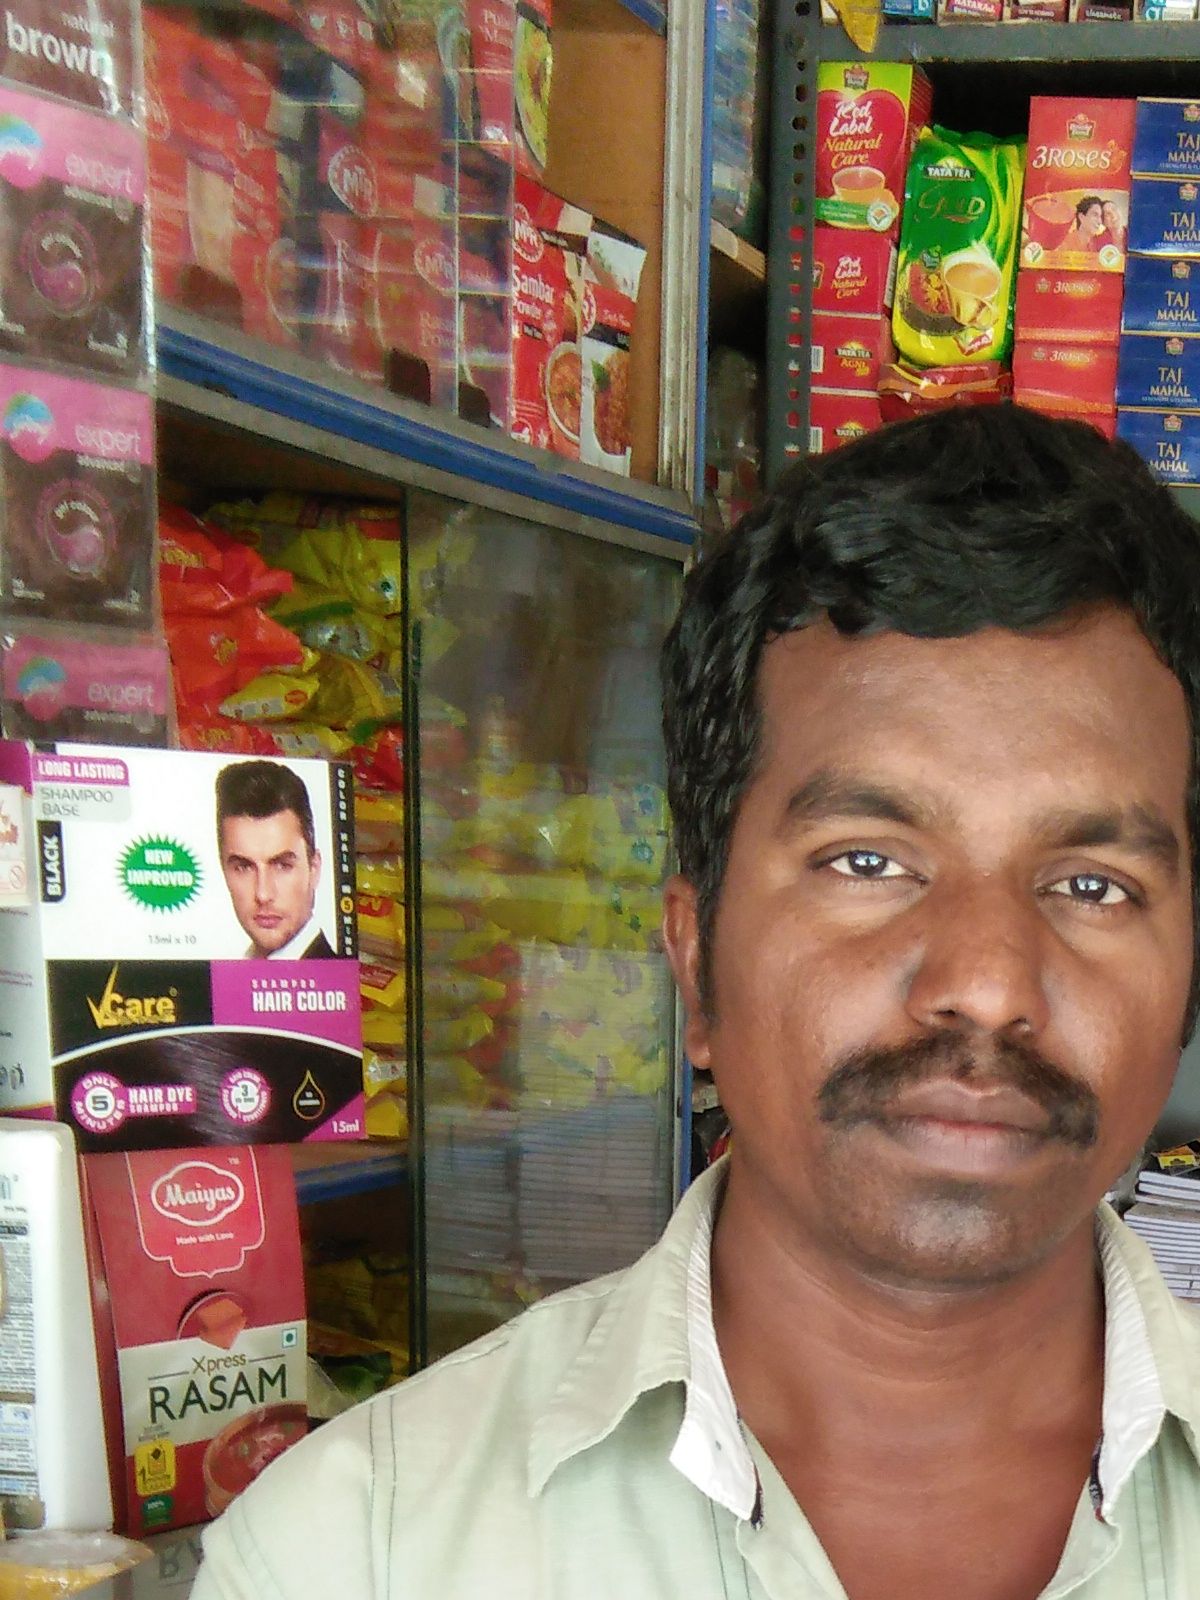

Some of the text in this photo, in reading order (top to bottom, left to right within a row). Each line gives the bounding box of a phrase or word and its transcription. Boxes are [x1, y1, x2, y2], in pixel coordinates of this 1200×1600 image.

[6, 10, 114, 84] brown
[829, 117, 873, 137] Label
[823, 133, 883, 152] Natural
[831, 152, 870, 169] Care
[926, 166, 972, 179] TATA TEA
[1171, 211, 1196, 228] TAJ
[1164, 291, 1190, 307] TAJ
[1157, 309, 1198, 322] MAHAL
[1158, 367, 1183, 383] TAJ
[1150, 385, 1191, 397] MAHAL
[1157, 442, 1181, 459] TAJ
[37, 759, 126, 780] LONG LASTING
[40, 787, 114, 803] SHAMPOO
[42, 803, 81, 817] BASE
[43, 834, 62, 897] BLACK
[144, 849, 174, 865] NEW
[126, 869, 194, 887] IMPROVED
[251, 978, 316, 990] SHAMPOO
[252, 990, 348, 1012] HAIR COLOR
[92, 1094, 110, 1113] 5
[128, 1086, 194, 1104] HAIR DYE
[330, 1119, 361, 1134] 15ml
[163, 1182, 236, 1212] Maiyas
[191, 1353, 248, 1378] Xpress
[148, 1362, 288, 1425] RASAM
